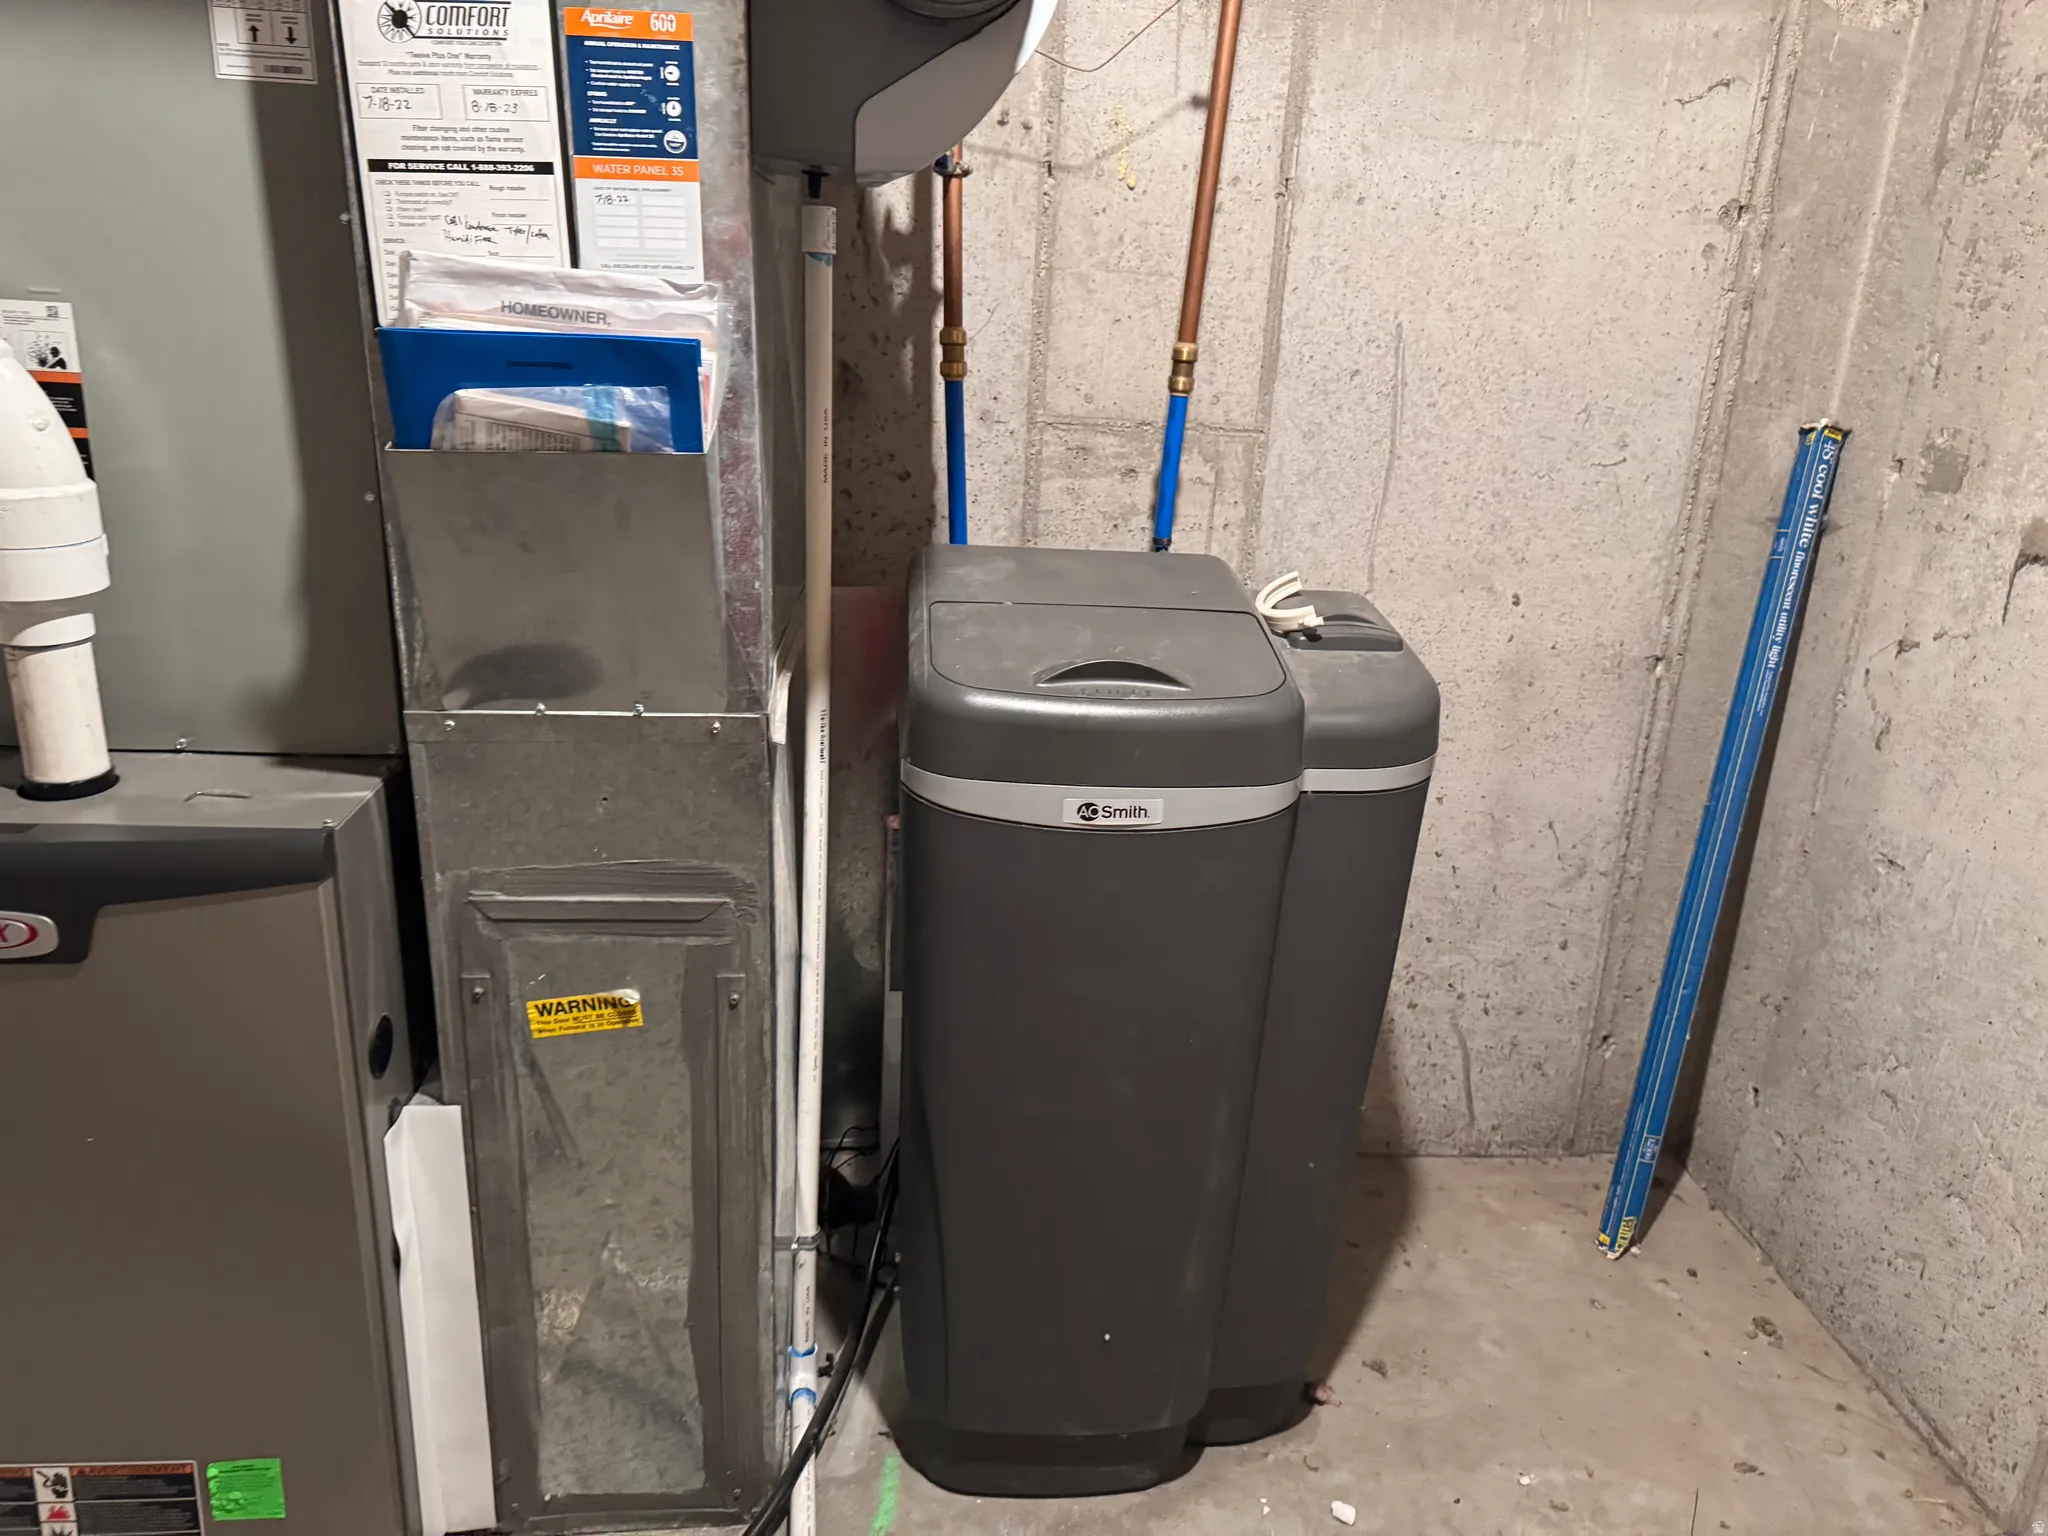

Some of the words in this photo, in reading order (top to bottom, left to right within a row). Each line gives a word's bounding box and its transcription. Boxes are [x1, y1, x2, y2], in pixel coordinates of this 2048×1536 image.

[426, 5, 511, 27] COMFORT
[581, 9, 634, 26] Aprilaire
[650, 13, 677, 32] 600
[428, 27, 509, 37] SOLUTIONS
[388, 162, 407, 170] FOR
[408, 163, 445, 171] SERVICE
[446, 163, 470, 171] CALL
[592, 163, 631, 175] WATER
[633, 165, 668, 176] PANEL
[671, 166, 684, 177] 35
[501, 299, 611, 327] HOMEOWNER,
[1811, 464, 1828, 499] cool
[1799, 503, 1819, 549] white
[1784, 551, 1805, 610] fluorescent
[1772, 611, 1789, 642] utility
[1766, 643, 1782, 669] light
